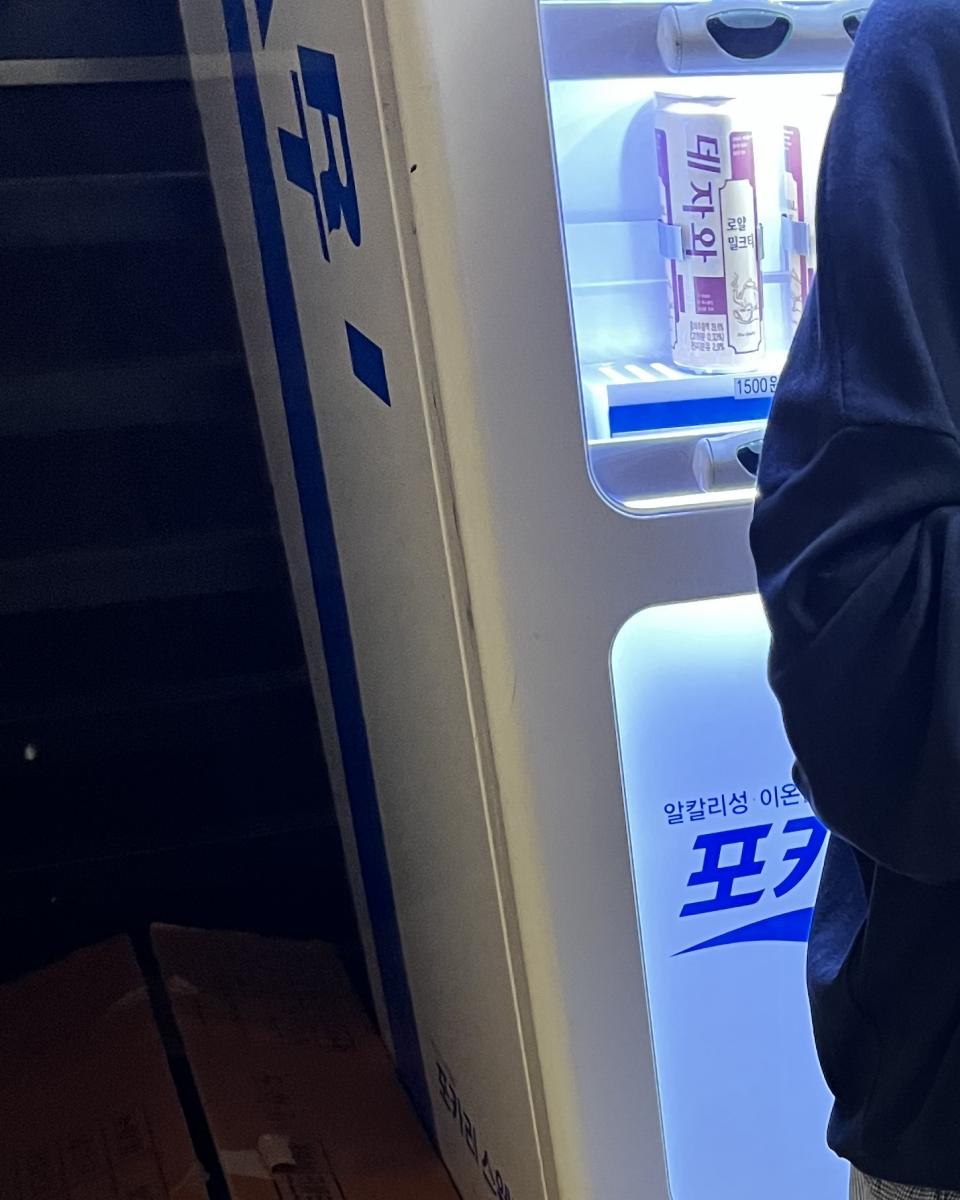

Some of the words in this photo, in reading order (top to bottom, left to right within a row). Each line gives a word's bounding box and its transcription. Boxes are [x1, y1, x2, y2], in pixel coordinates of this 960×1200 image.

[682, 134, 721, 263] 데자와
[663, 790, 748, 825] 알칼리성
[760, 783, 808, 809] 이온
